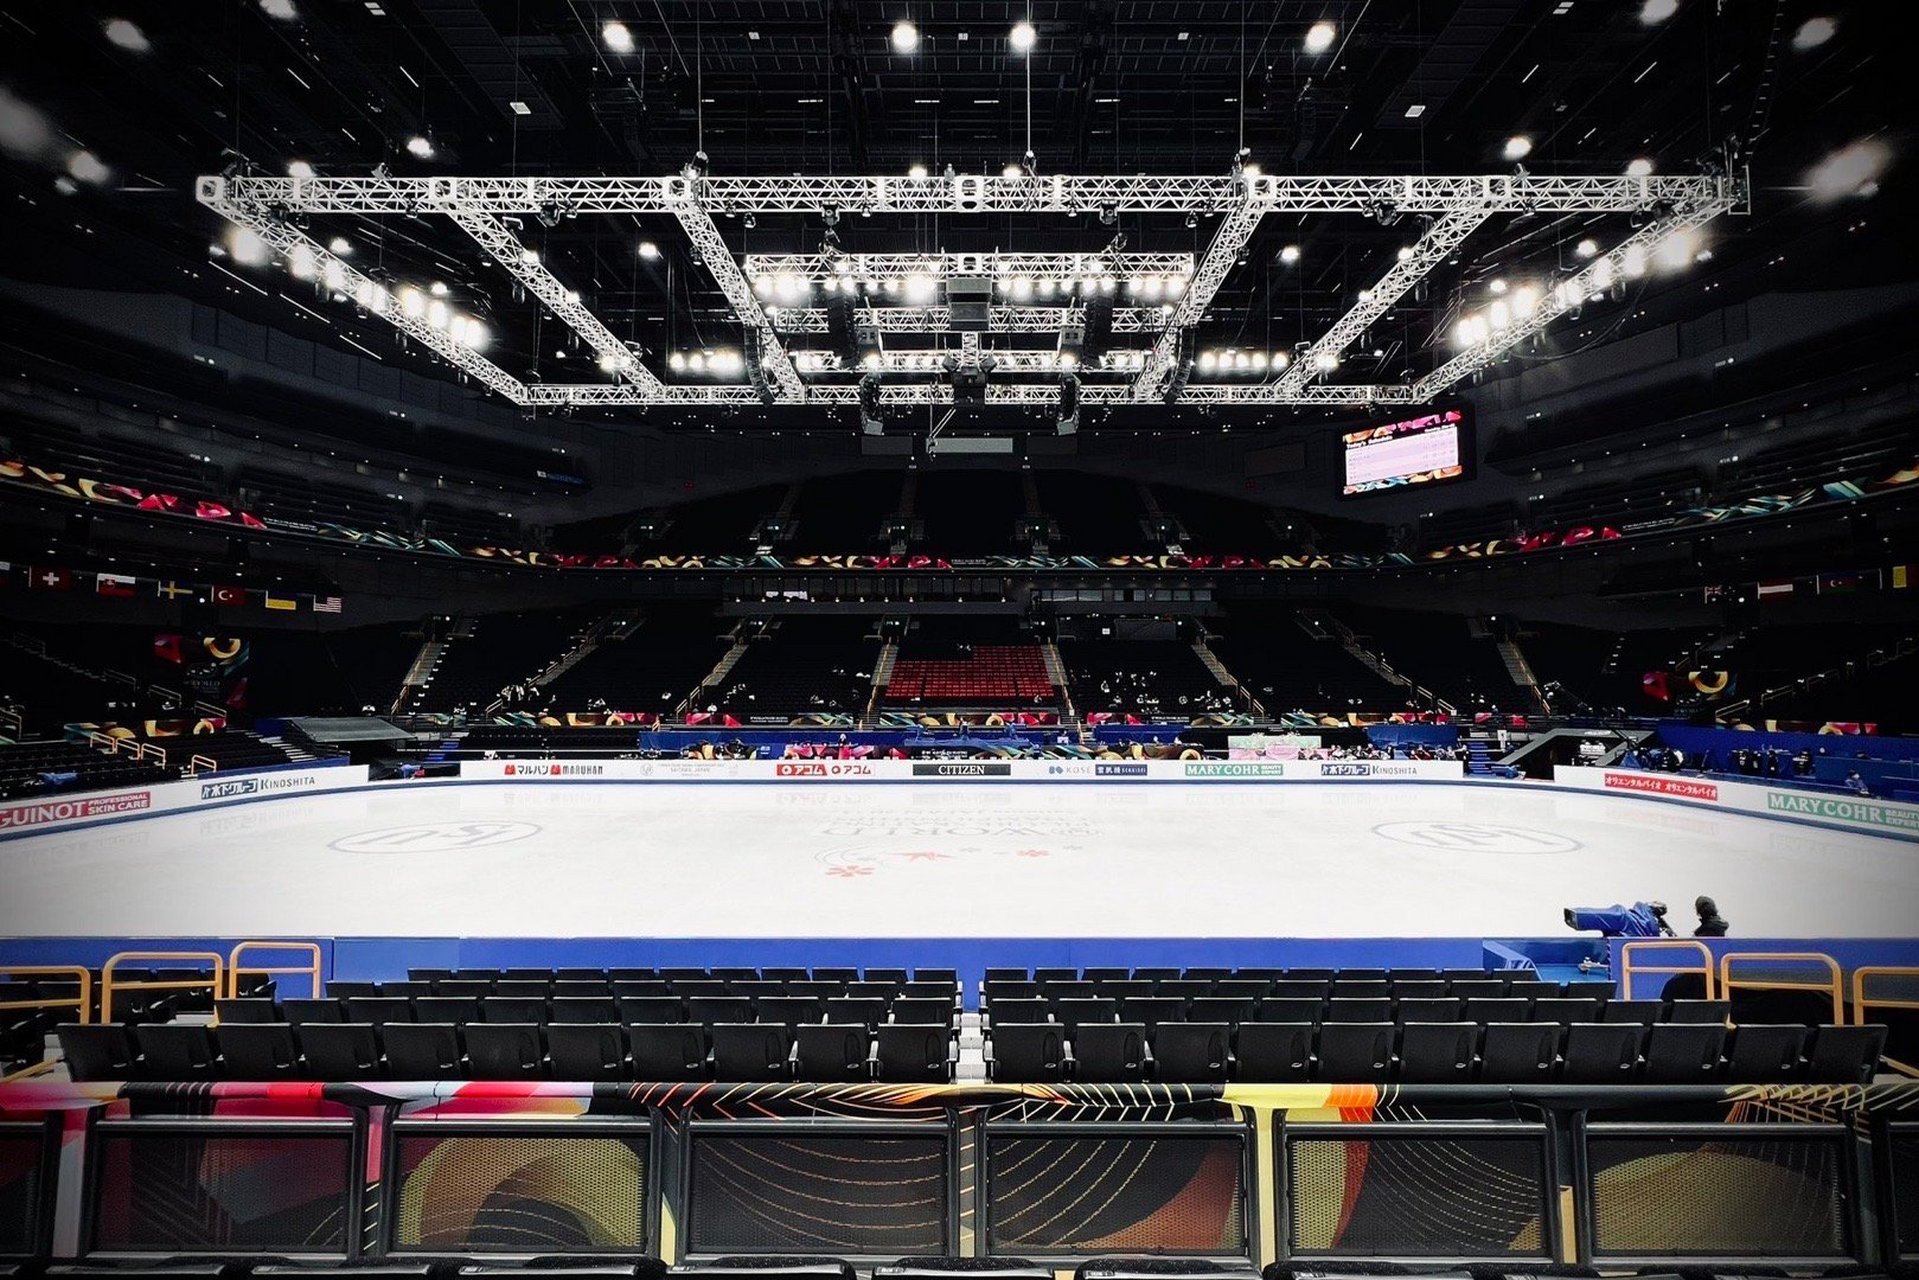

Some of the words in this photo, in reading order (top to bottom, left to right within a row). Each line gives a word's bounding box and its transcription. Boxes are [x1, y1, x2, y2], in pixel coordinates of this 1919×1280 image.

[517, 765, 549, 776] マルハン
[562, 766, 603, 775] MARUHAN
[794, 765, 824, 775] アコム
[843, 765, 872, 775] アコム
[938, 765, 985, 775] CITIZEN
[1187, 765, 1223, 775] MARY
[1223, 765, 1261, 775] COHR
[261, 776, 315, 790] KINOSHITA
[88, 793, 149, 807] PROFESSIONAL
[88, 804, 116, 815] SKIN
[117, 799, 149, 811] CARE
[1770, 794, 1821, 813] MARY
[1823, 801, 1884, 823] COHR
[0, 802, 87, 828] GUINOT
